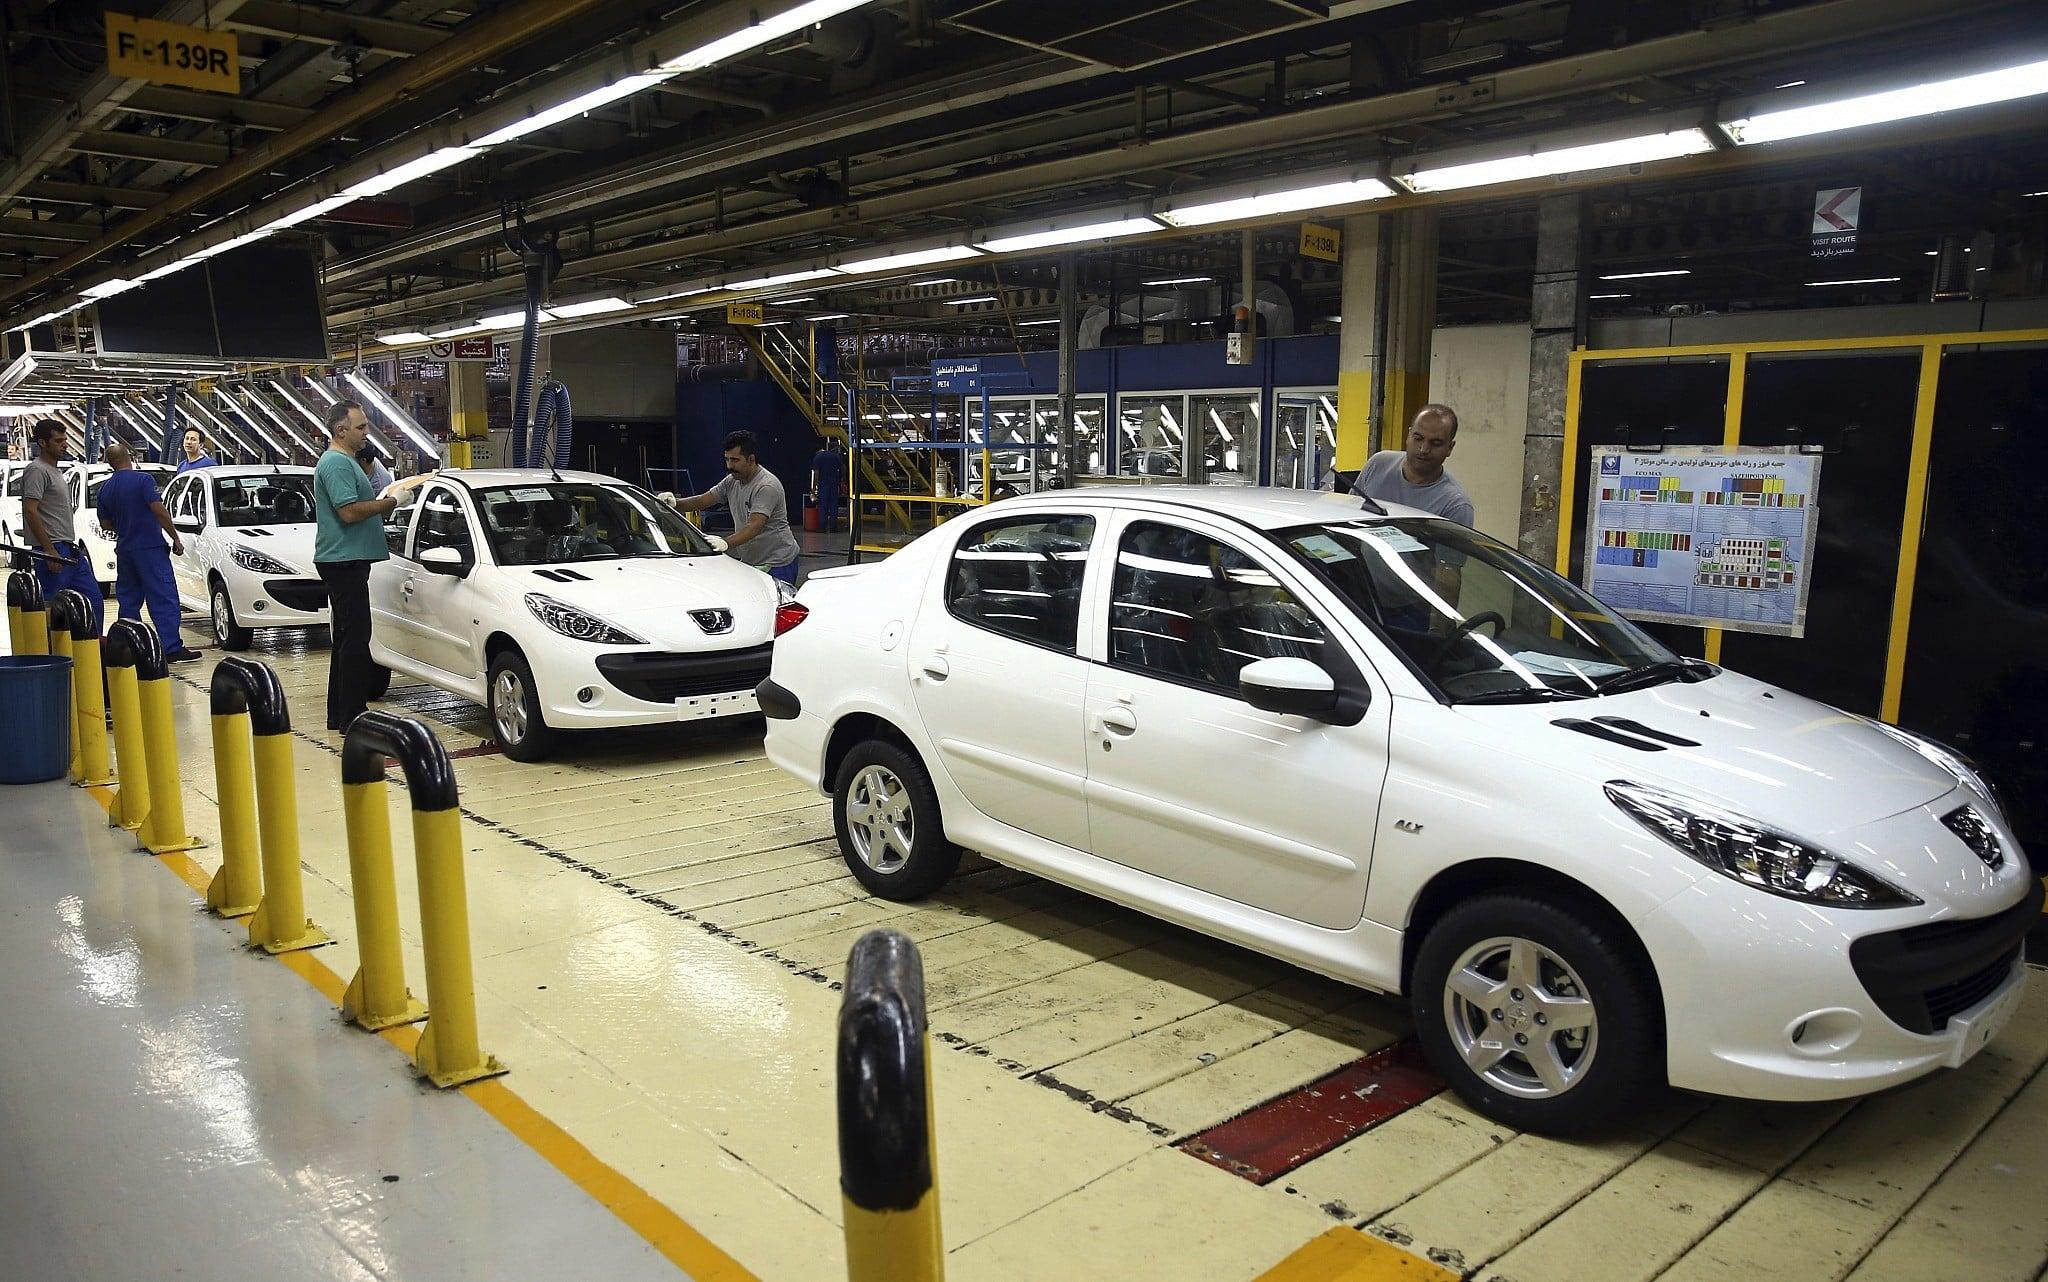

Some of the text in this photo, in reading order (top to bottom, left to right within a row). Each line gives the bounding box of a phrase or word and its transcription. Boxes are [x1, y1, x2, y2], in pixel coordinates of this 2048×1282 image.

[1304, 234, 1336, 253] F-139L
[1831, 235, 1856, 244] ROUTE
[1833, 248, 1855, 256] مسیر
